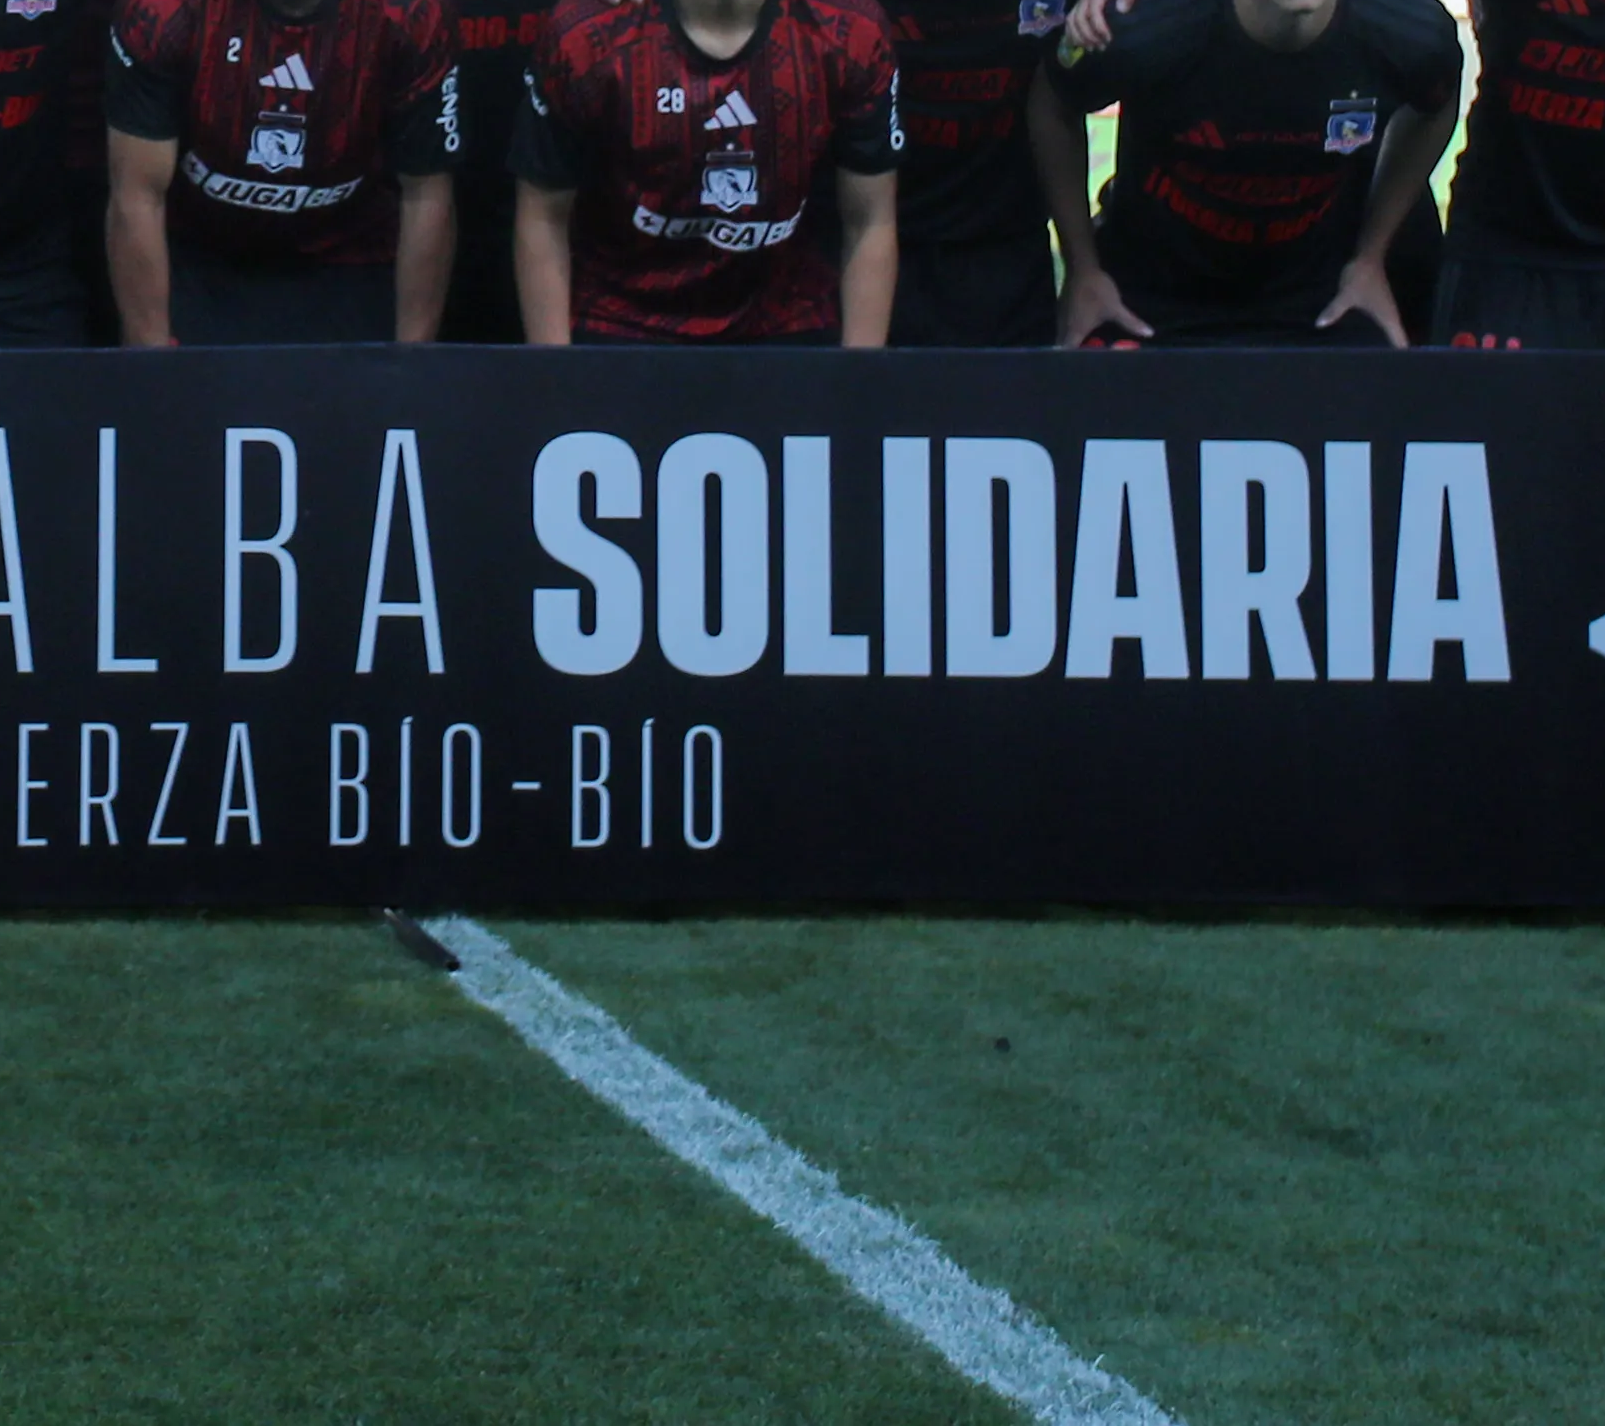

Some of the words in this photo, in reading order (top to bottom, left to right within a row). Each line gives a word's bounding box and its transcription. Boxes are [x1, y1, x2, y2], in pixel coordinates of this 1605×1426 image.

[225, 35, 243, 63] 2
[655, 85, 686, 115] 28
[530, 429, 1513, 684] SOLIDARIA
[328, 713, 723, 852] BÍO-BÍO
